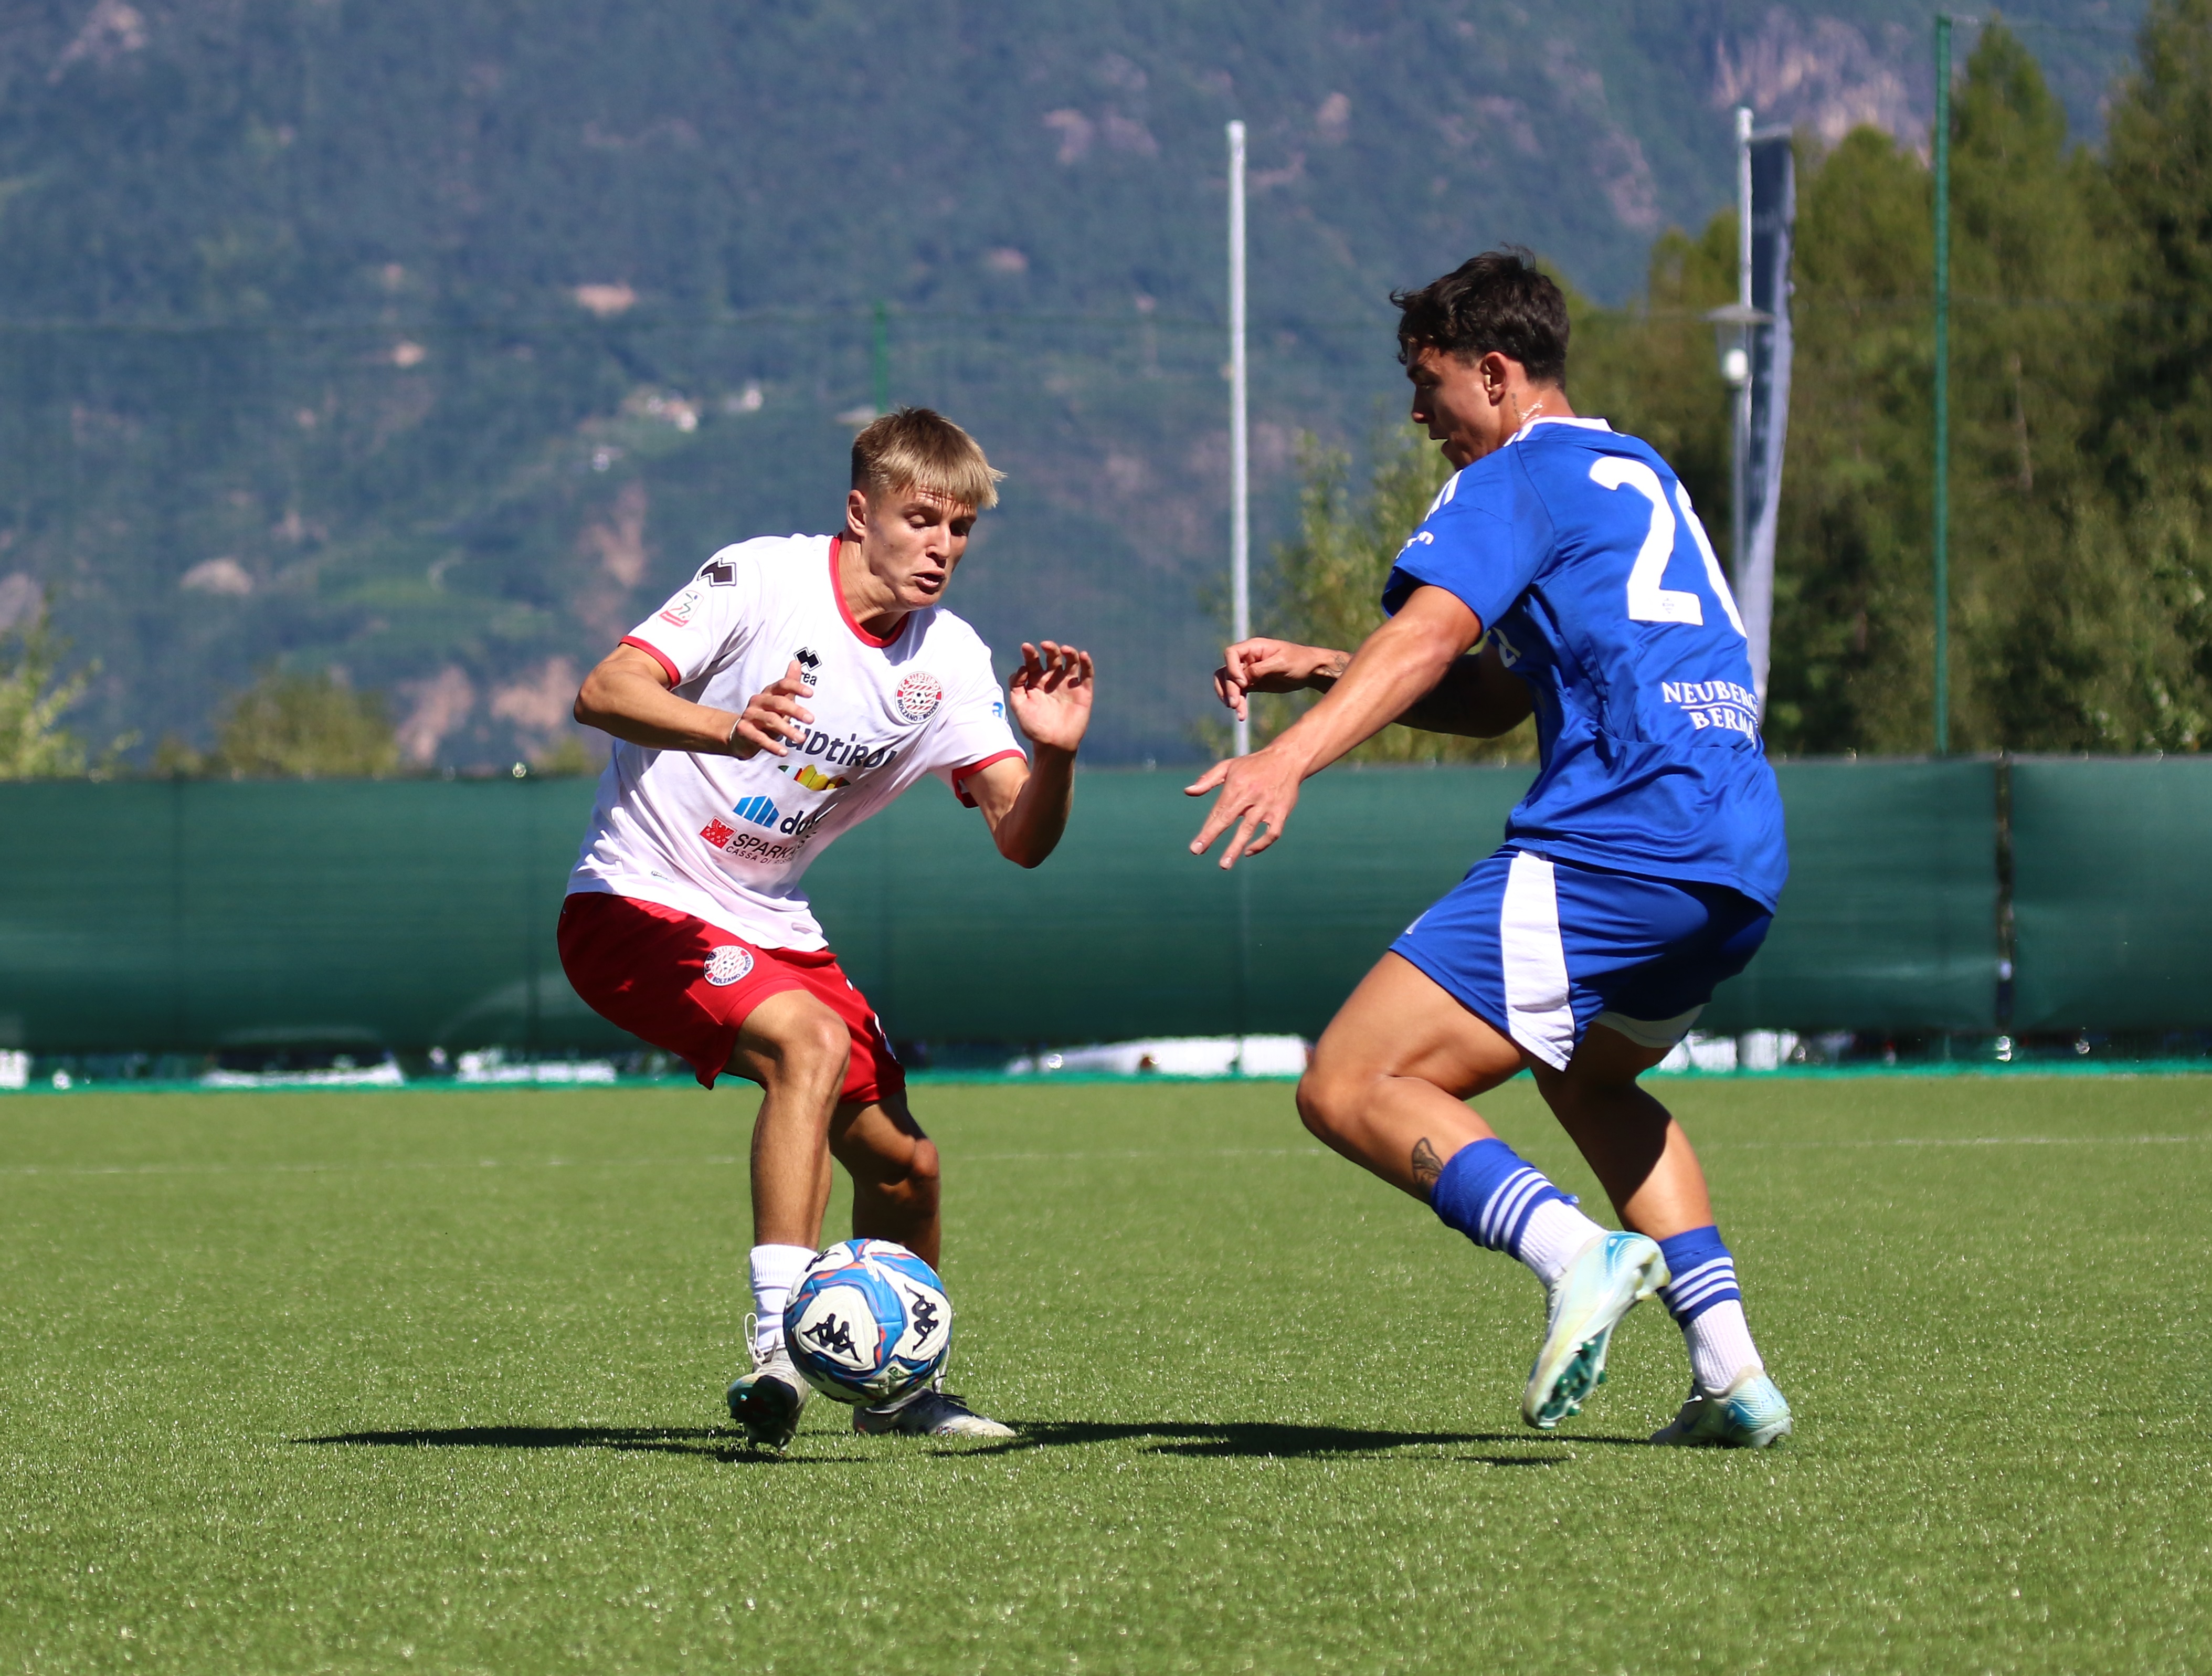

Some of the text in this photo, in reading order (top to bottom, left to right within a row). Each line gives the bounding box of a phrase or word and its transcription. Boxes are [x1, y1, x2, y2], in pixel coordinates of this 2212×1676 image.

[897, 699, 939, 721] BOLZANO BOZEN
[726, 846, 757, 861] CASSA
[712, 973, 741, 984] BOLZANO
